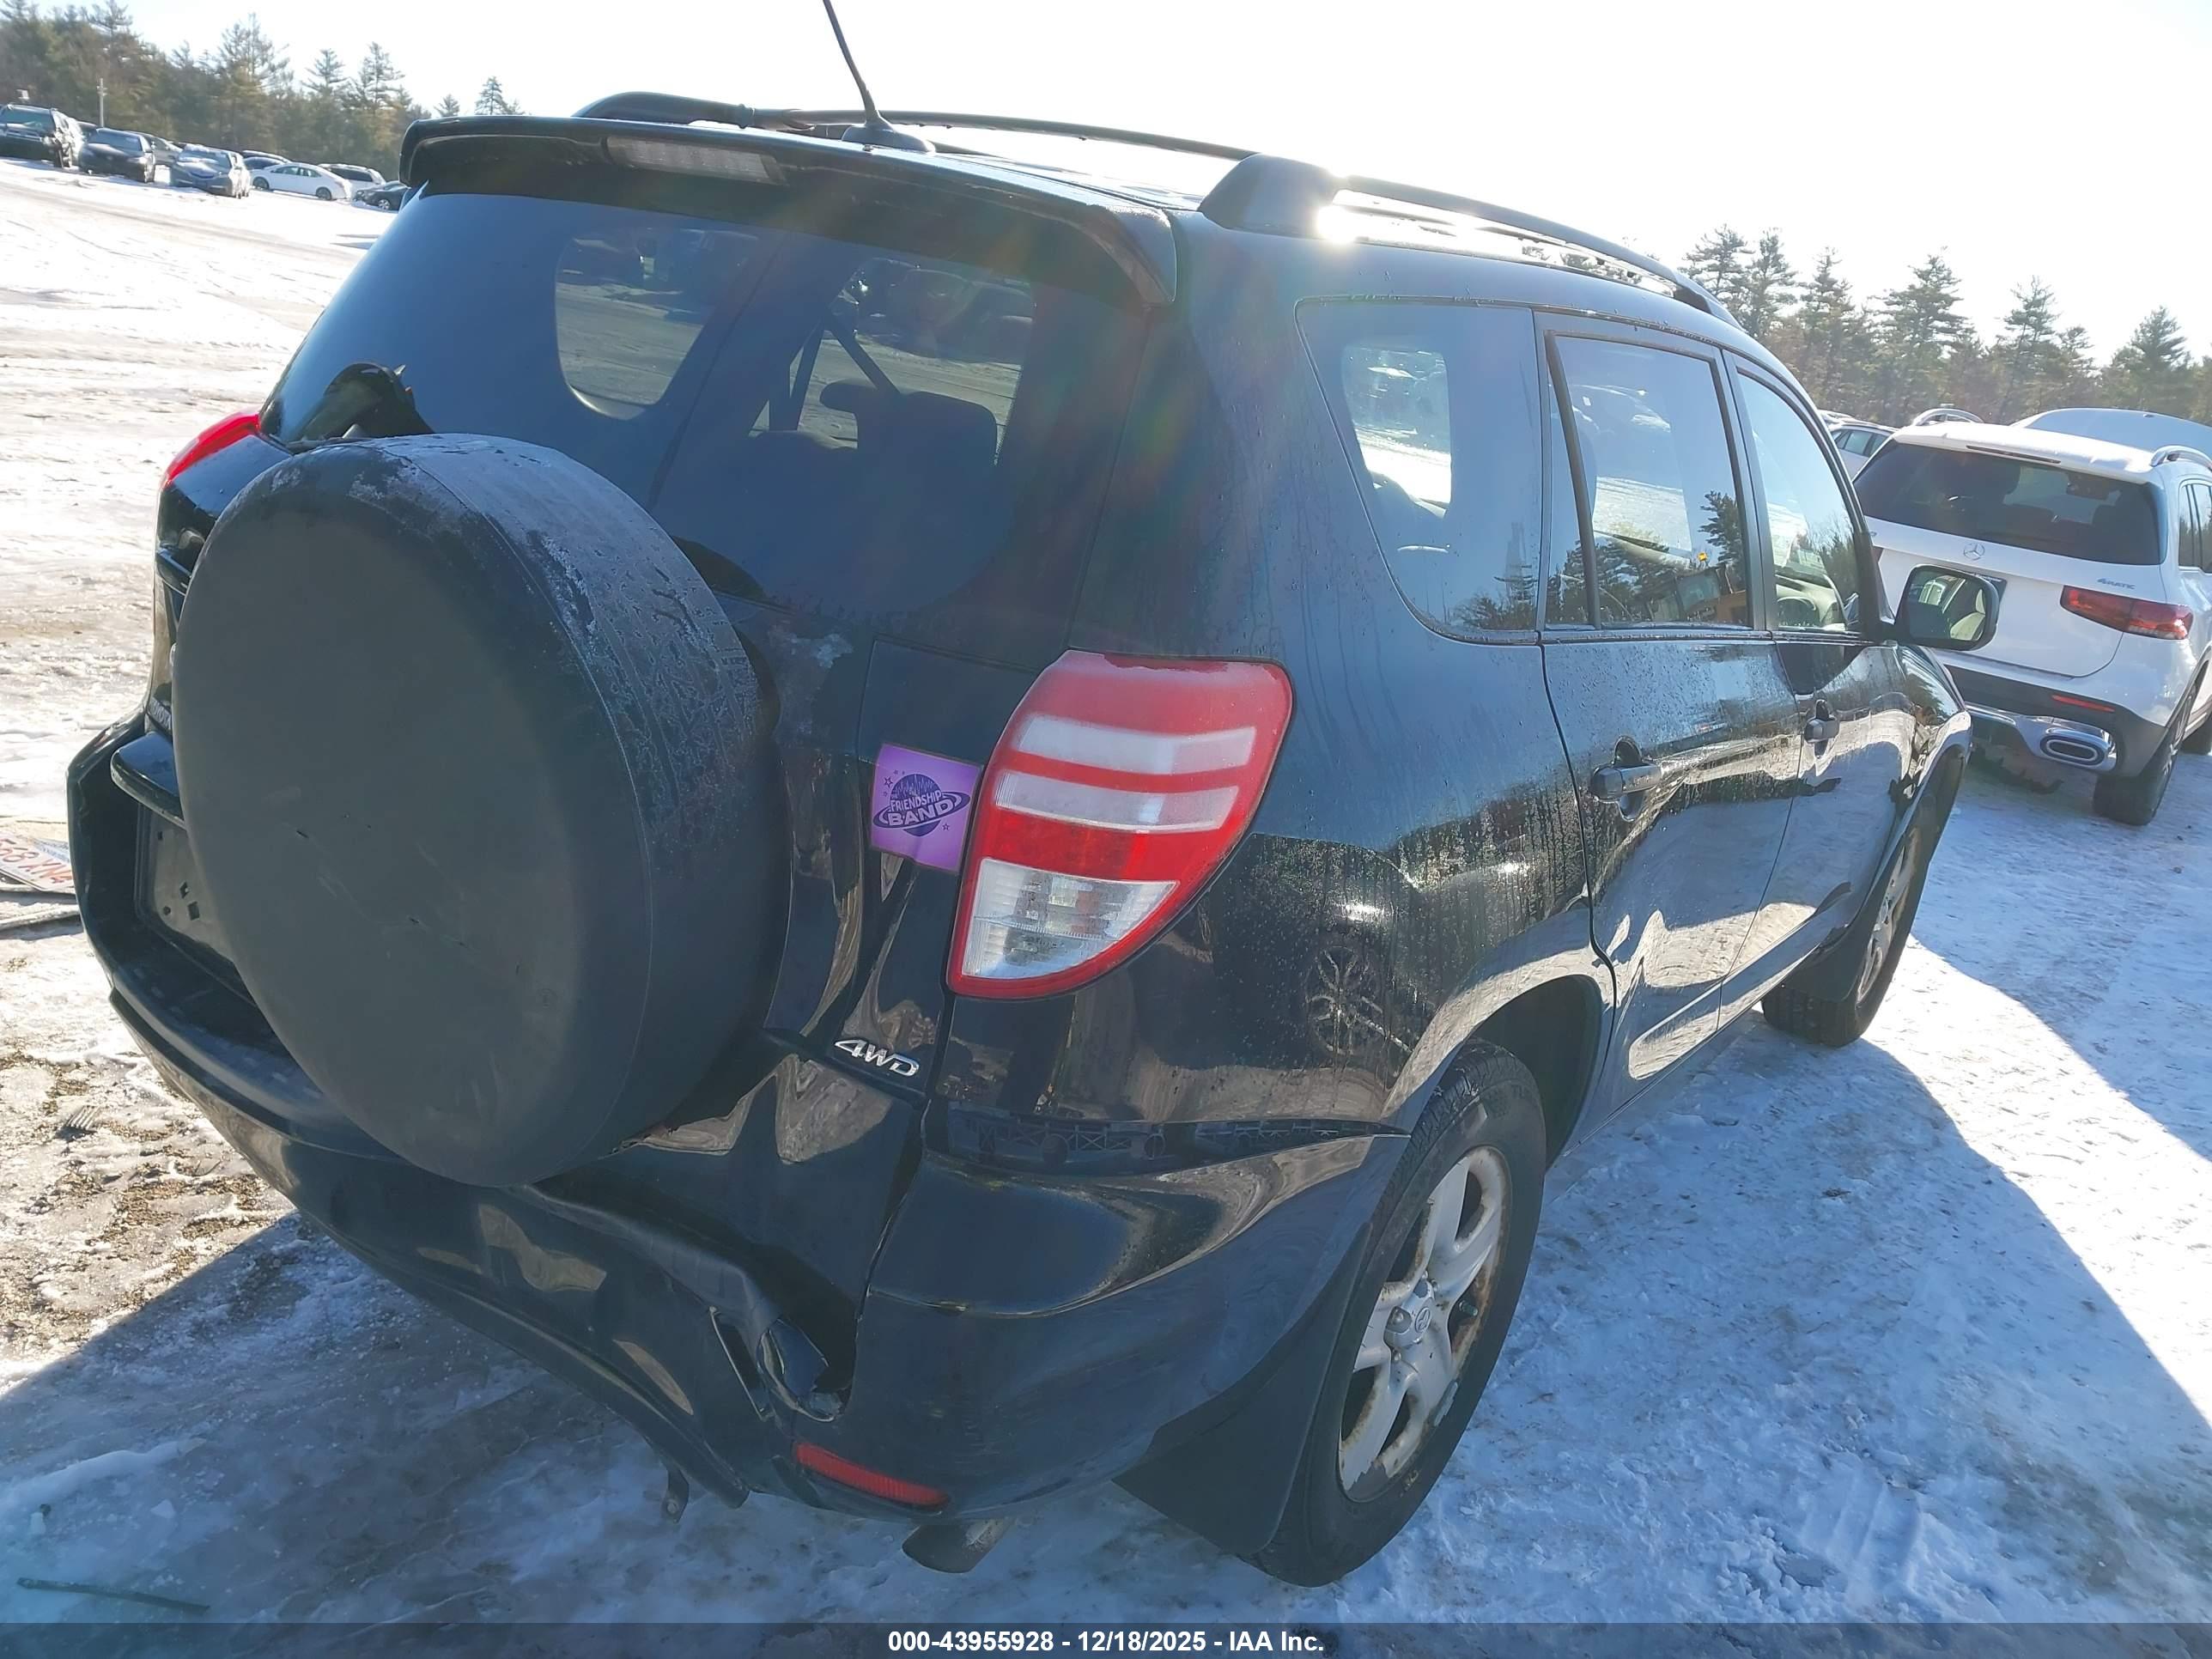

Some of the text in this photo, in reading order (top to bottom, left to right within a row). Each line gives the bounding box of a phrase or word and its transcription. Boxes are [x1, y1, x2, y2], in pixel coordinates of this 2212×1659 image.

[887, 799, 954, 826] BAND
[890, 789, 942, 812] FRIENDSHIP
[834, 1039, 920, 1077] 4WD
